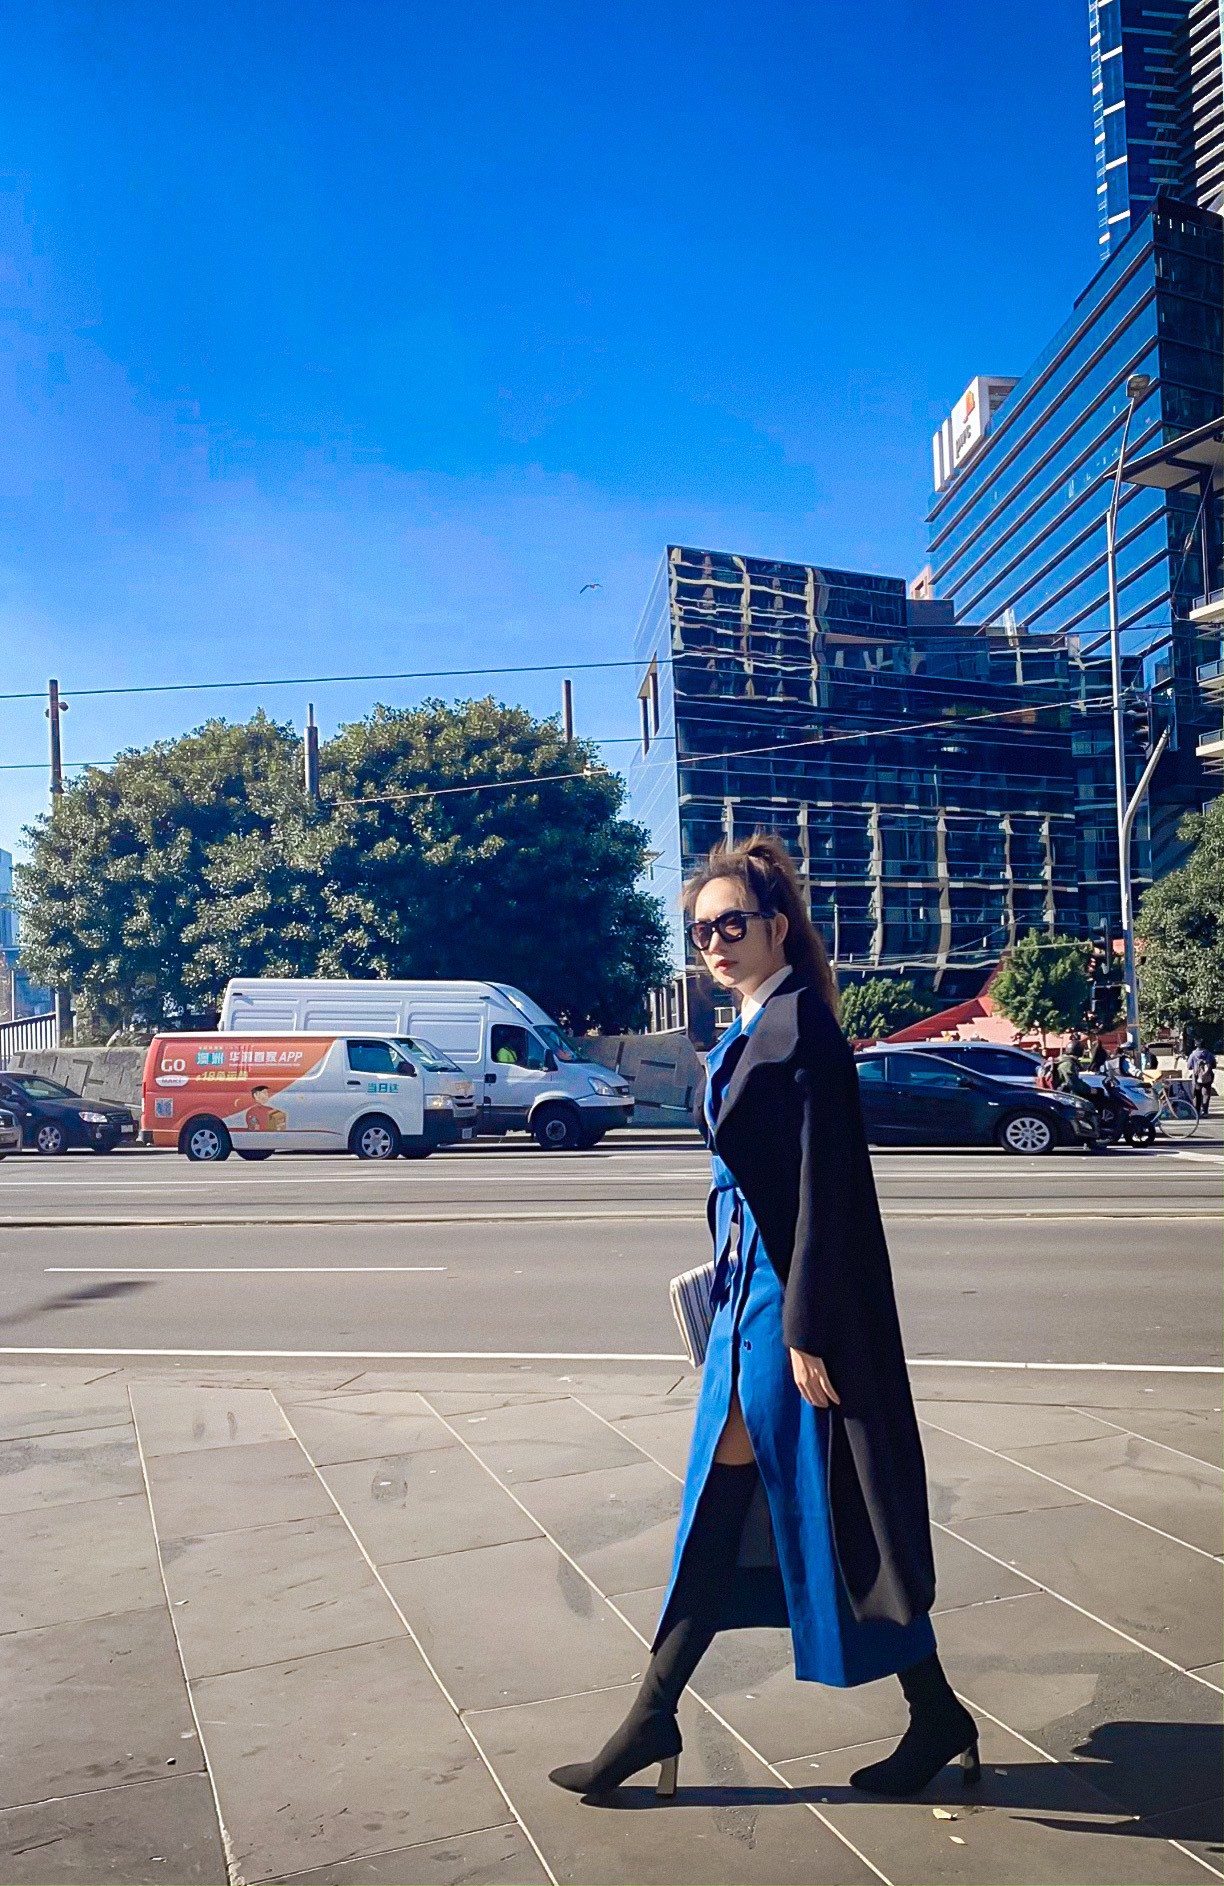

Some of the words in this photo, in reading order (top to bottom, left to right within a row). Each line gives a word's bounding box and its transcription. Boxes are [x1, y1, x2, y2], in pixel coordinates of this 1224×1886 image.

[161, 1059, 186, 1072] GO
[367, 1083, 400, 1094] 当日达
